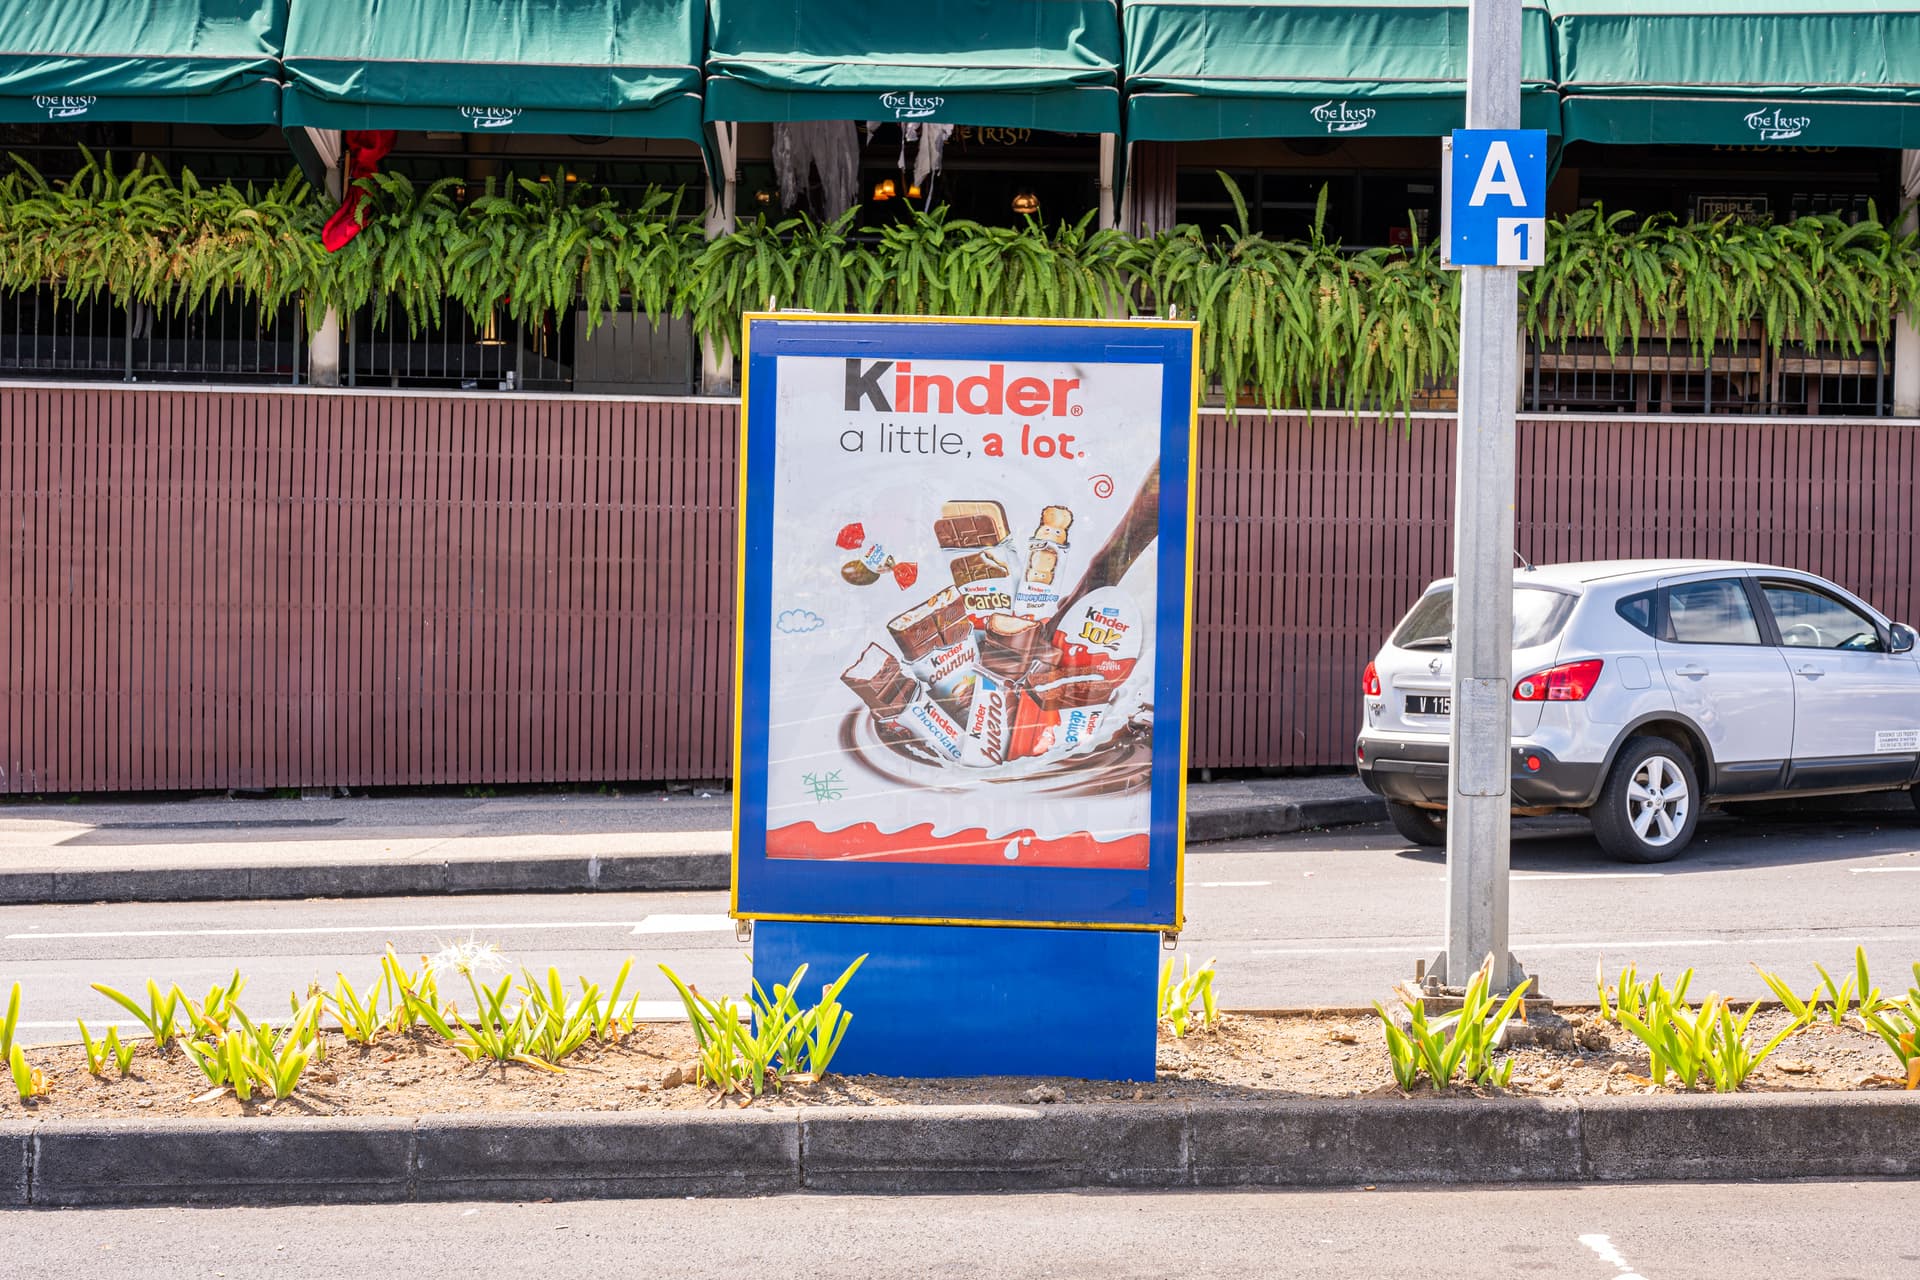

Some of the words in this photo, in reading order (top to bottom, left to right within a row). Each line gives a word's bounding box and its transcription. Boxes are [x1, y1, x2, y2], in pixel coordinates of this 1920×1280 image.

[1468, 141, 1527, 207] A
[1514, 223, 1528, 260] 1
[845, 358, 1081, 417] Kinder
[840, 430, 864, 452] a
[880, 422, 971, 458] little,
[982, 433, 1004, 457] a
[1021, 424, 1085, 460] lot.
[964, 593, 1011, 610] Cards
[1085, 606, 1130, 632] Kinder
[930, 643, 964, 668] Kinder
[924, 701, 959, 738] Kinder
[969, 704, 987, 740] Kinder
[1420, 697, 1427, 713] V
[912, 705, 962, 759] Chocolate
[980, 692, 1003, 766] bueno
